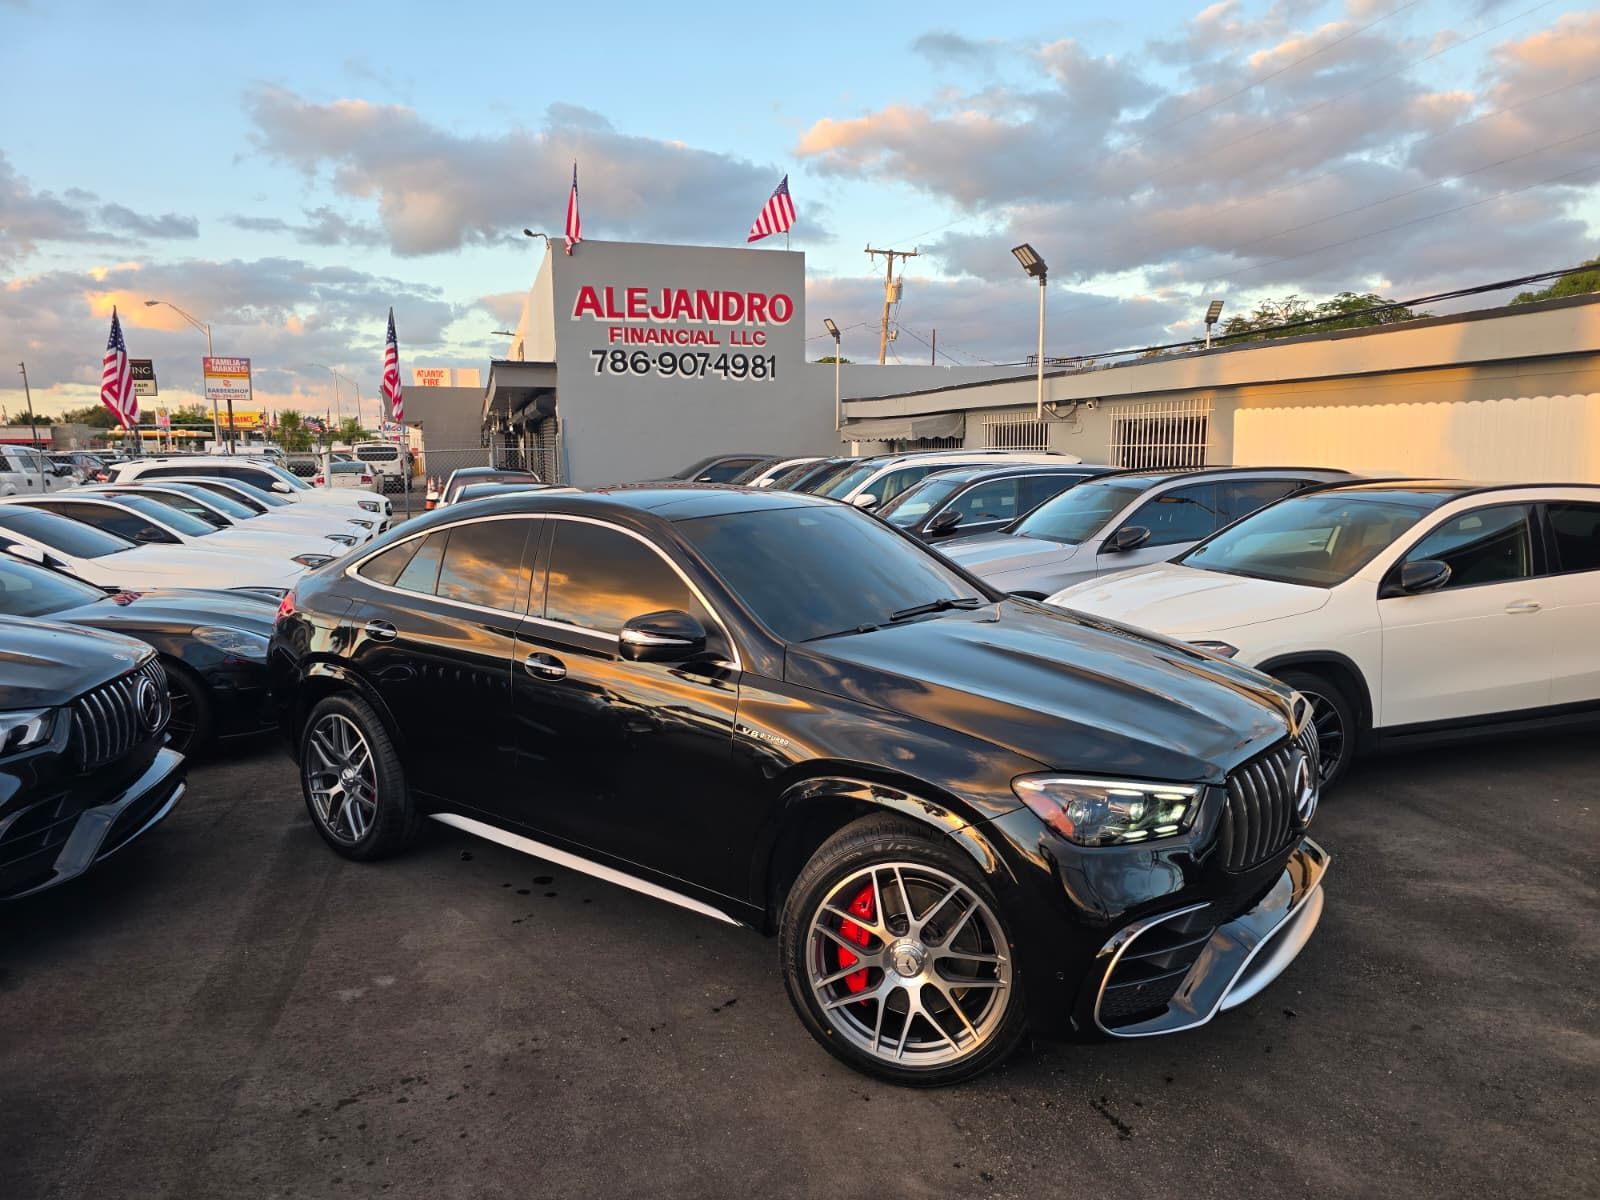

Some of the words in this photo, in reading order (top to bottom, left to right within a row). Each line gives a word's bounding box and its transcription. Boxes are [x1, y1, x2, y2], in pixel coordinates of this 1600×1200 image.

[571, 286, 793, 325] ALEJANDRO
[608, 326, 720, 346] FINANCIAL
[729, 330, 767, 347] LLC
[212, 365, 241, 373] MARKET
[416, 369, 445, 378] ATLANTIC
[422, 378, 440, 387] FIRE
